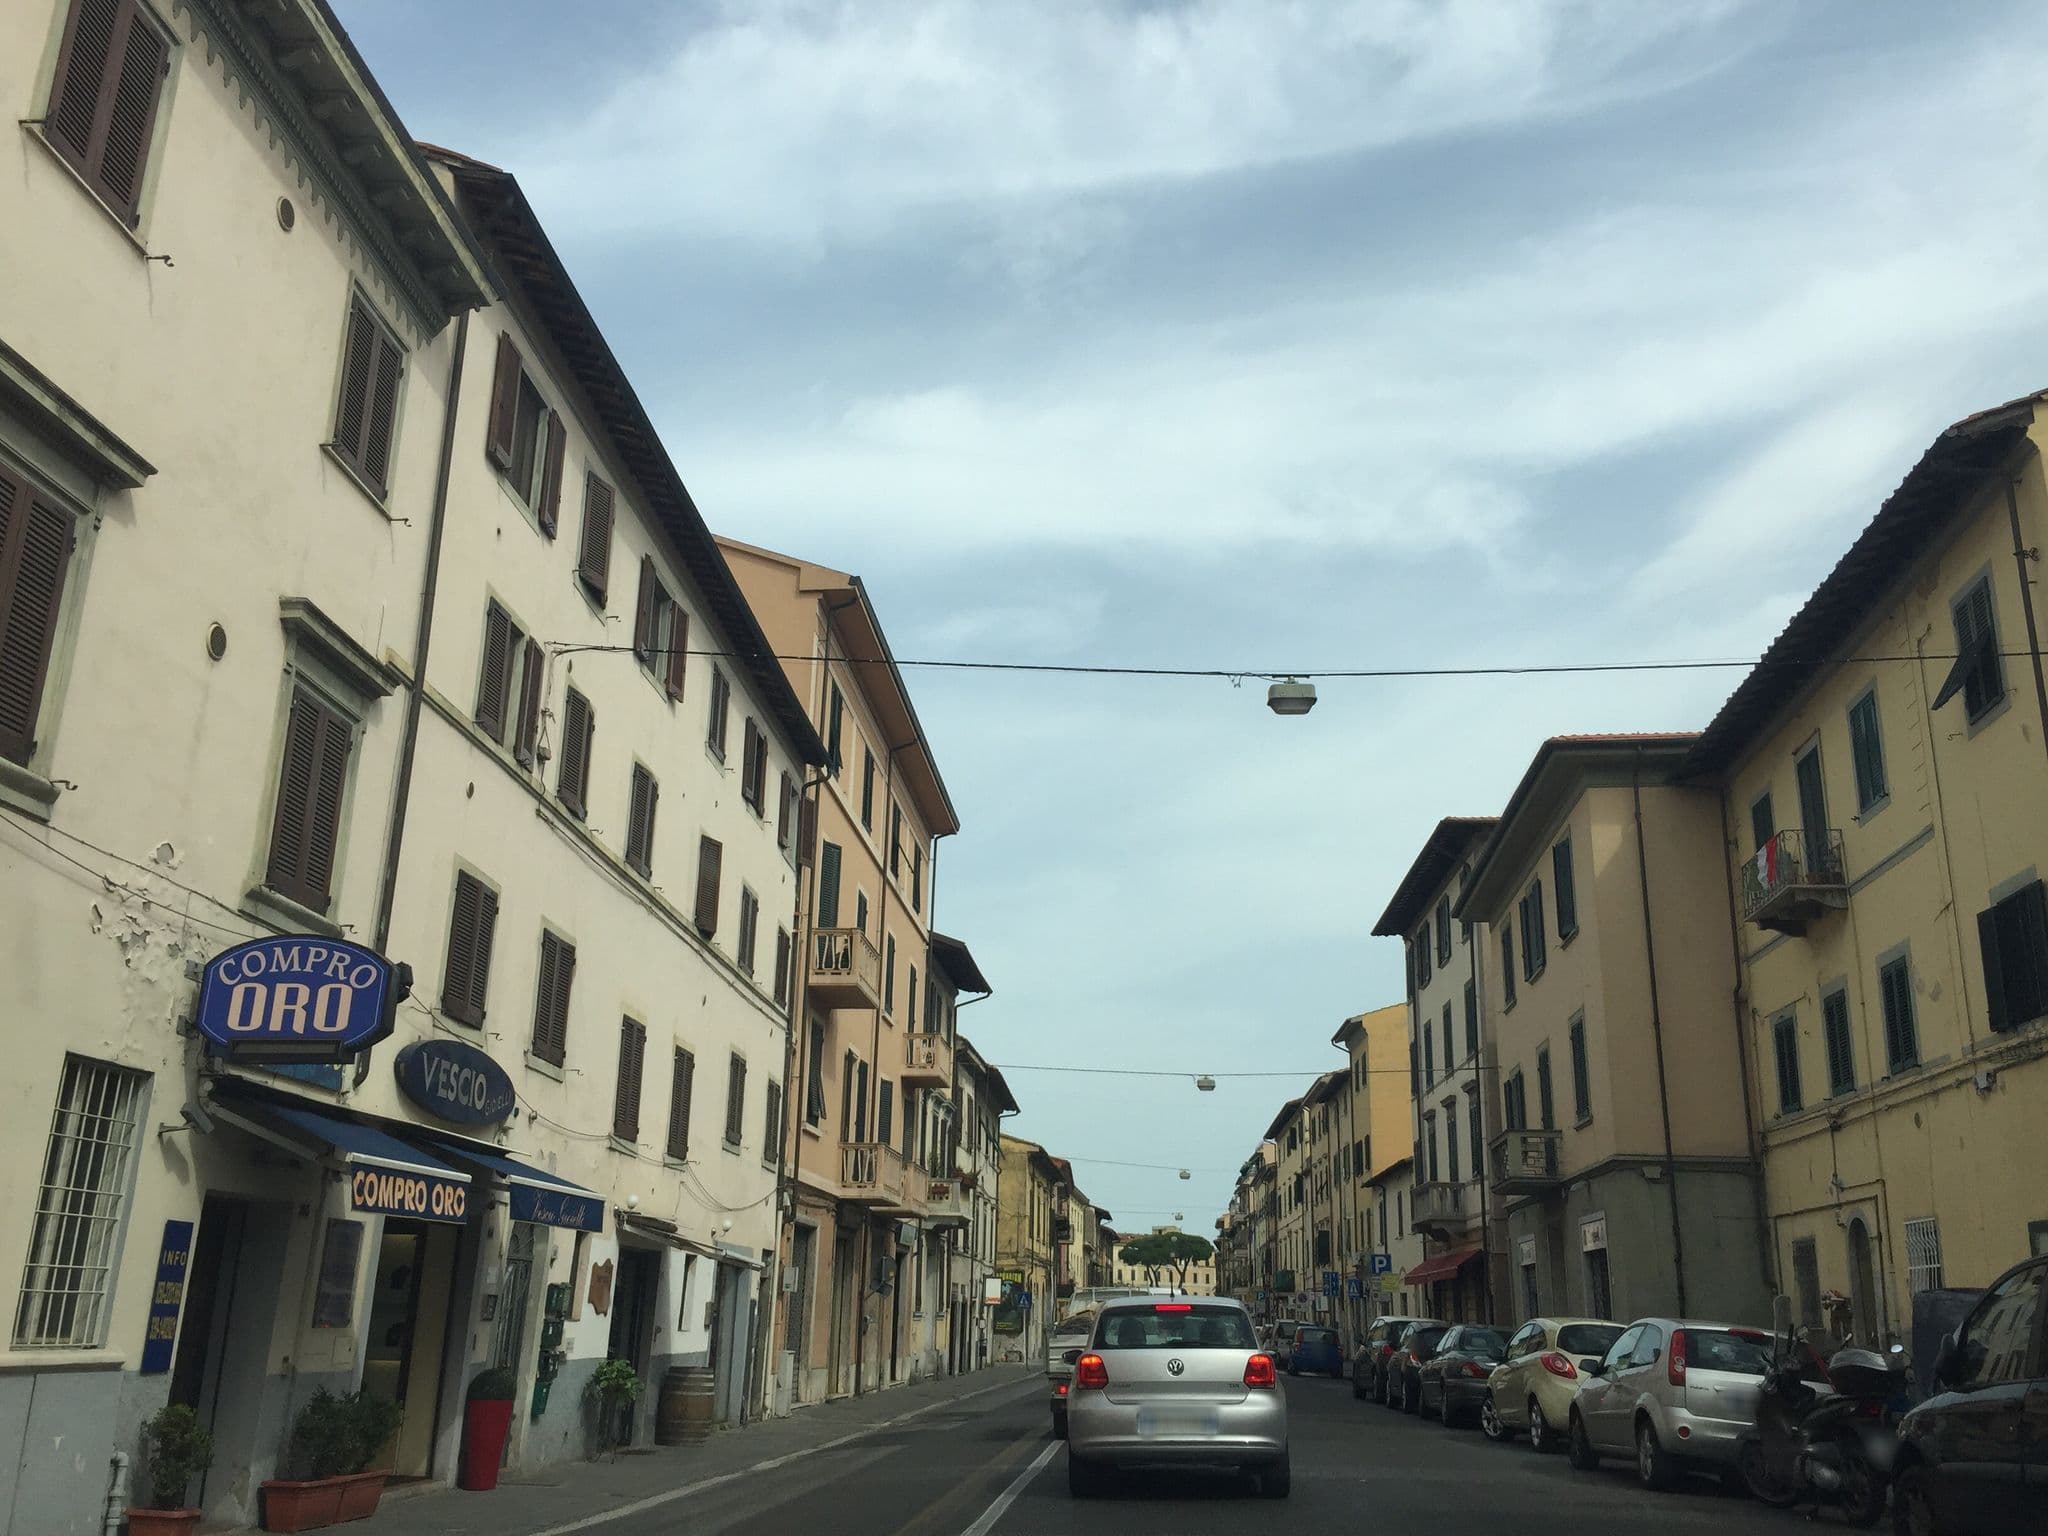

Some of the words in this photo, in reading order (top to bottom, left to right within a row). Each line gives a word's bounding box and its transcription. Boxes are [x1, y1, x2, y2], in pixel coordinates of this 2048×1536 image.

[218, 946, 377, 990] COMPRO
[227, 983, 353, 1033] ORO
[422, 1051, 487, 1111] VESCIO
[352, 1171, 428, 1211] COMPRO
[431, 1181, 466, 1217] ORO
[162, 1249, 187, 1266] INFO
[1374, 1256, 1387, 1274] P
